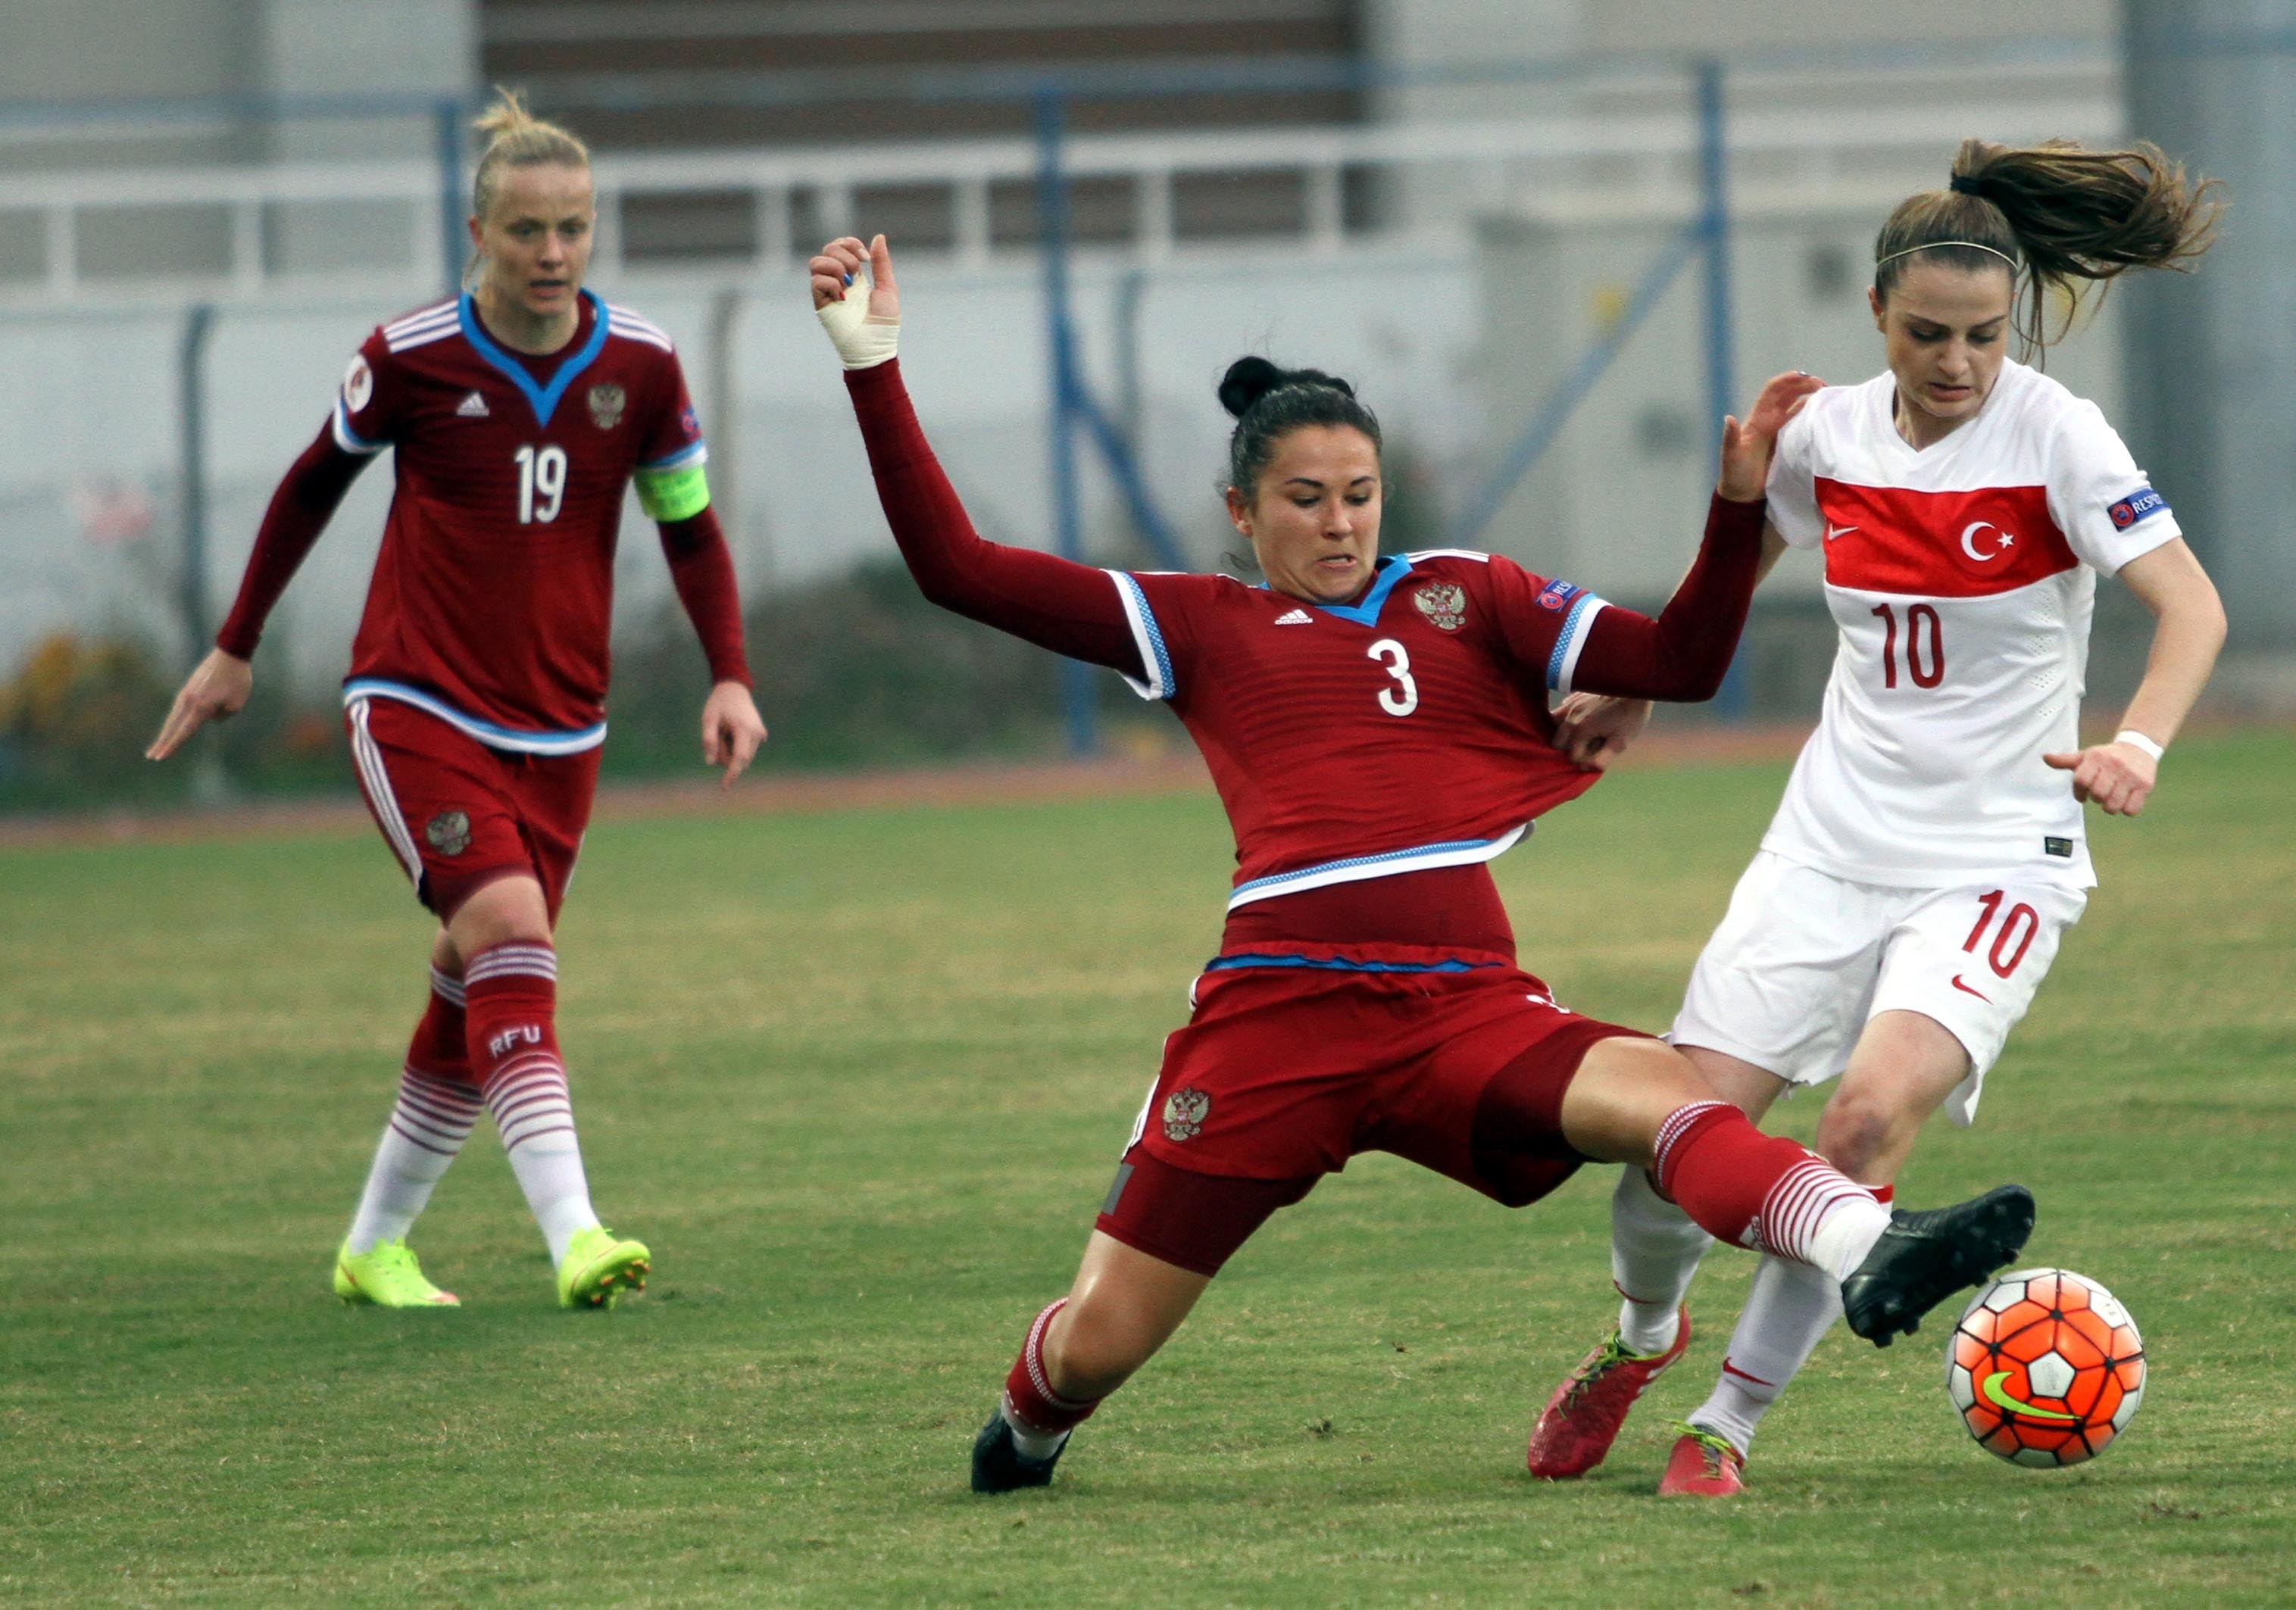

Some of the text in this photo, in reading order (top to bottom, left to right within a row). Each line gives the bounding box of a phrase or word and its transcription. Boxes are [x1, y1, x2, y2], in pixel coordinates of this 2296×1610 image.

[514, 445, 567, 524] 19
[1367, 638, 1419, 716] 3
[1871, 603, 1945, 689] 10
[1962, 889, 2040, 979] 10
[489, 1025, 541, 1059] RFU
